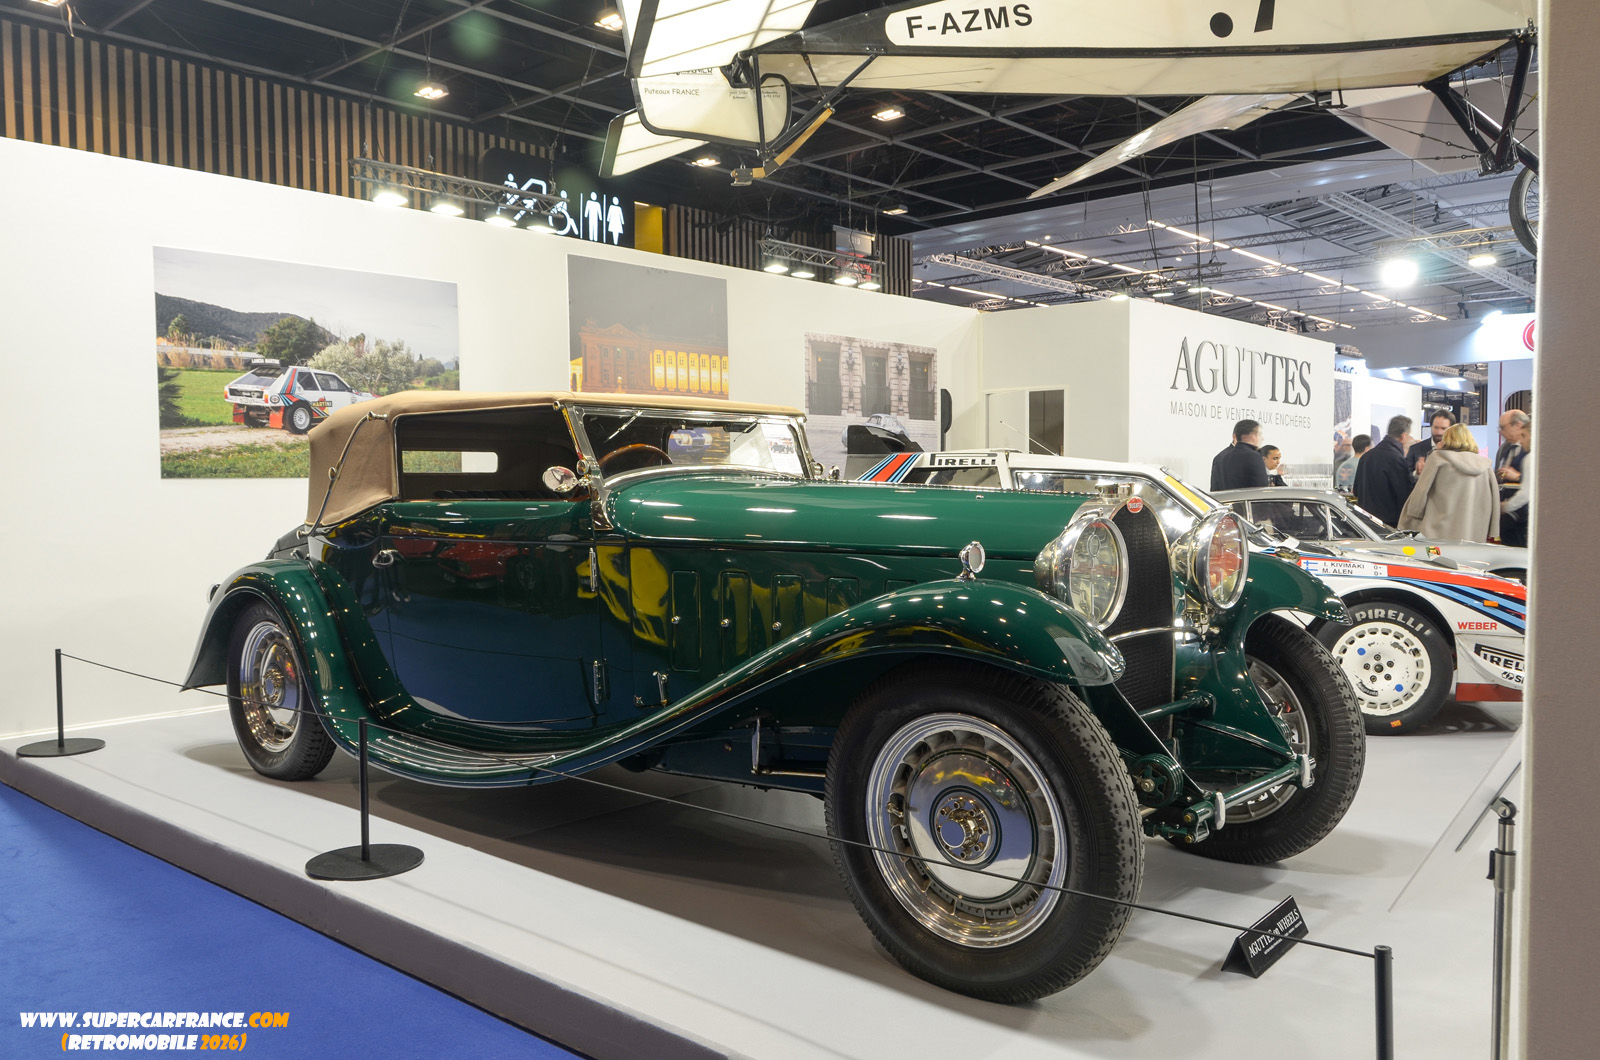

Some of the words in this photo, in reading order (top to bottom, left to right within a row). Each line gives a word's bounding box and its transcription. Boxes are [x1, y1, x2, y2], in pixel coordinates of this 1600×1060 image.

[906, 4, 1034, 39] F-AZMS
[644, 87, 670, 95] Puteaux
[672, 88, 700, 96] FRANCE
[1170, 336, 1312, 407] AGUTTES
[1170, 401, 1207, 418] MAISON
[1210, 405, 1222, 420] DE
[1225, 407, 1256, 421] VENTES
[1258, 411, 1273, 424] AUX
[929, 453, 998, 466] PIRELLI
[1355, 608, 1424, 632] PIRELLI
[1457, 621, 1498, 630] WEBER
[1473, 643, 1525, 672] PIREL
[1276, 908, 1300, 932] WHEELS
